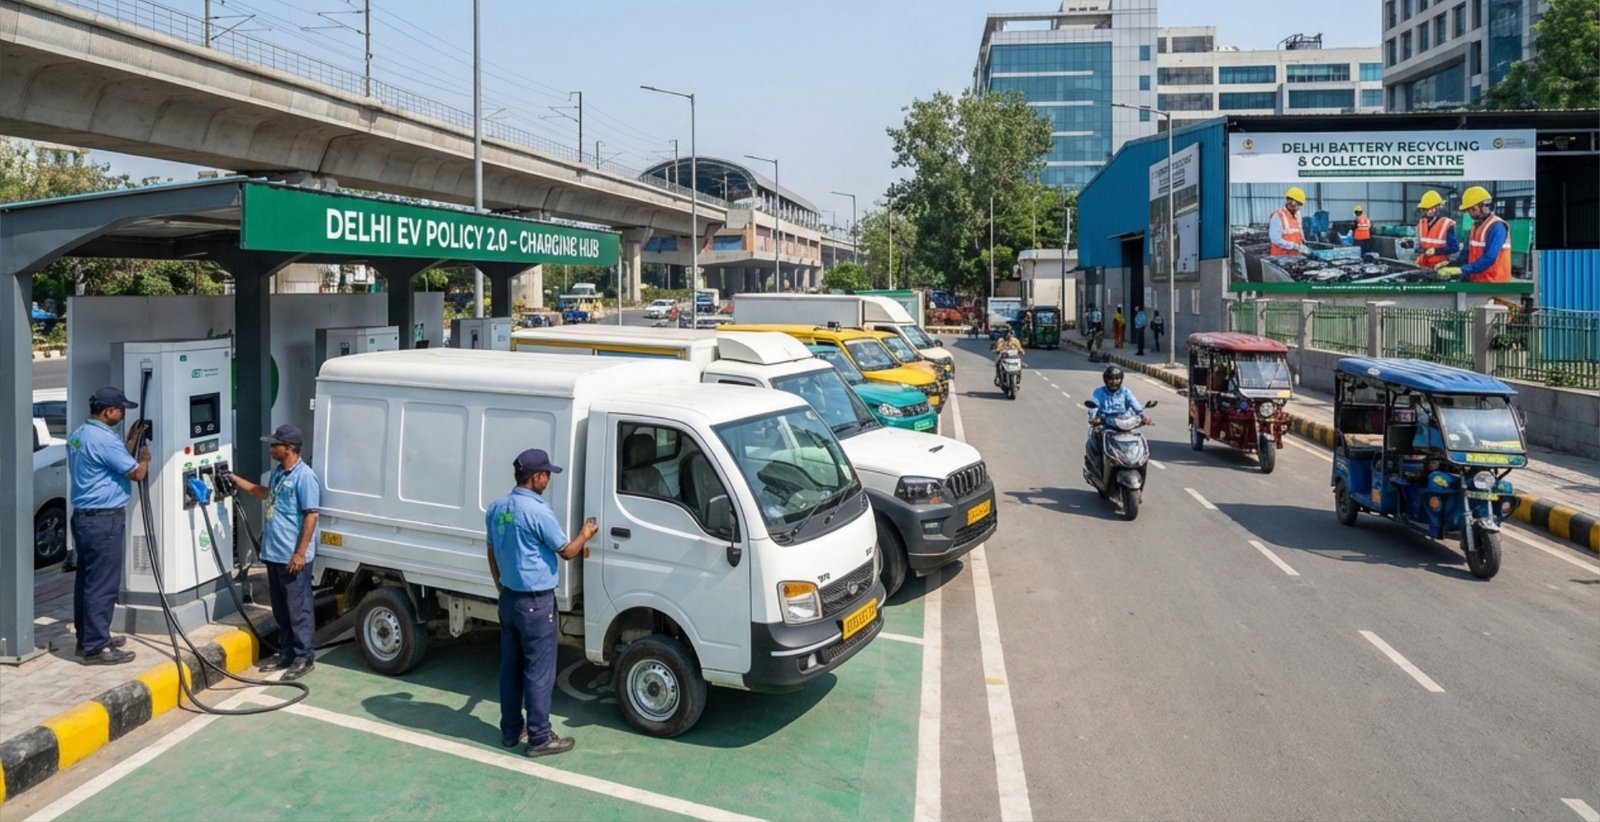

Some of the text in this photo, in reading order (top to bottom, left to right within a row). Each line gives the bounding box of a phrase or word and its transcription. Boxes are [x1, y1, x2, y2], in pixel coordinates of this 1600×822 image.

[1282, 141, 1480, 154] DELHI BATTERY RECYCLING
[1297, 154, 1465, 167] & COLLECTION CENTRE
[326, 207, 391, 244] DELHI
[397, 216, 422, 246] EV
[426, 219, 484, 251] POLICY
[486, 226, 508, 252] 2.0
[580, 238, 600, 258] HUB
